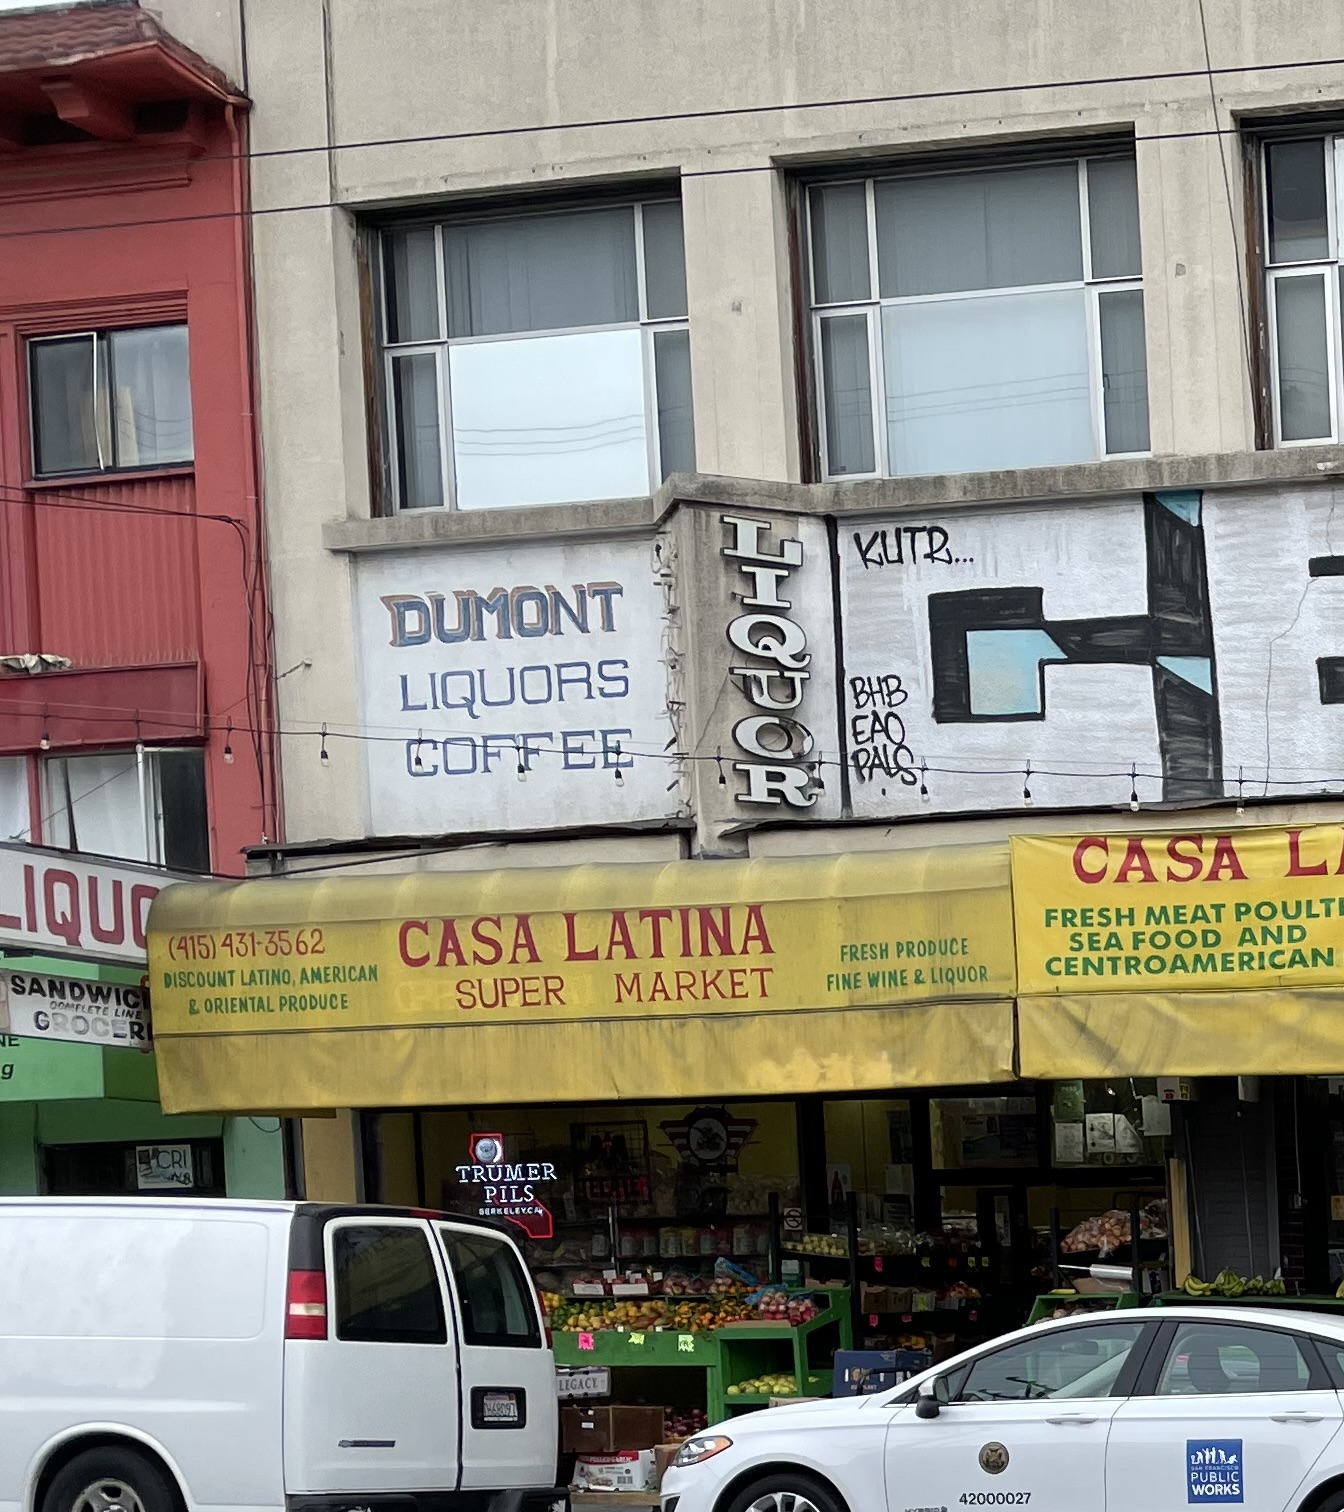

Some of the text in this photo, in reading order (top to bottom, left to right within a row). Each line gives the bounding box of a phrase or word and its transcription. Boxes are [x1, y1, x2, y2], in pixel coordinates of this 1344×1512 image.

[379, 581, 624, 647] DUMONT
[720, 514, 819, 808] LIQUOR
[400, 659, 629, 719] LIQUORS
[850, 674, 908, 709] BHB
[405, 728, 634, 777] COFFEE
[1072, 835, 1249, 884] CASA
[1045, 905, 1137, 929] FRESH
[1143, 902, 1227, 927] MEAT
[168, 927, 326, 961] (415) 431-3562
[399, 903, 777, 968] CASA LATINA
[840, 936, 970, 963] FRESH PRODUCE
[1068, 924, 1308, 953] SEA FOOD AND
[1045, 946, 1336, 978] CENTROAMERICAN
[164, 969, 236, 989] DISCOUNT
[300, 964, 379, 985] AMERICAN
[455, 967, 775, 1010] SUPER MARKET
[826, 964, 989, 992] FINE WINE & LIQUOR
[50, 1000, 143, 1021] COMPLETE LINE
[188, 992, 349, 1016] & ORIENTAL PRODUCE
[156, 1149, 187, 1170] CRI
[455, 1162, 557, 1183] TRUMER
[484, 1184, 535, 1203] PILS
[1190, 1471, 1240, 1483] PUBLIC
[1191, 1483, 1241, 1496] WORKS
[959, 1492, 1032, 1505] 42000027
